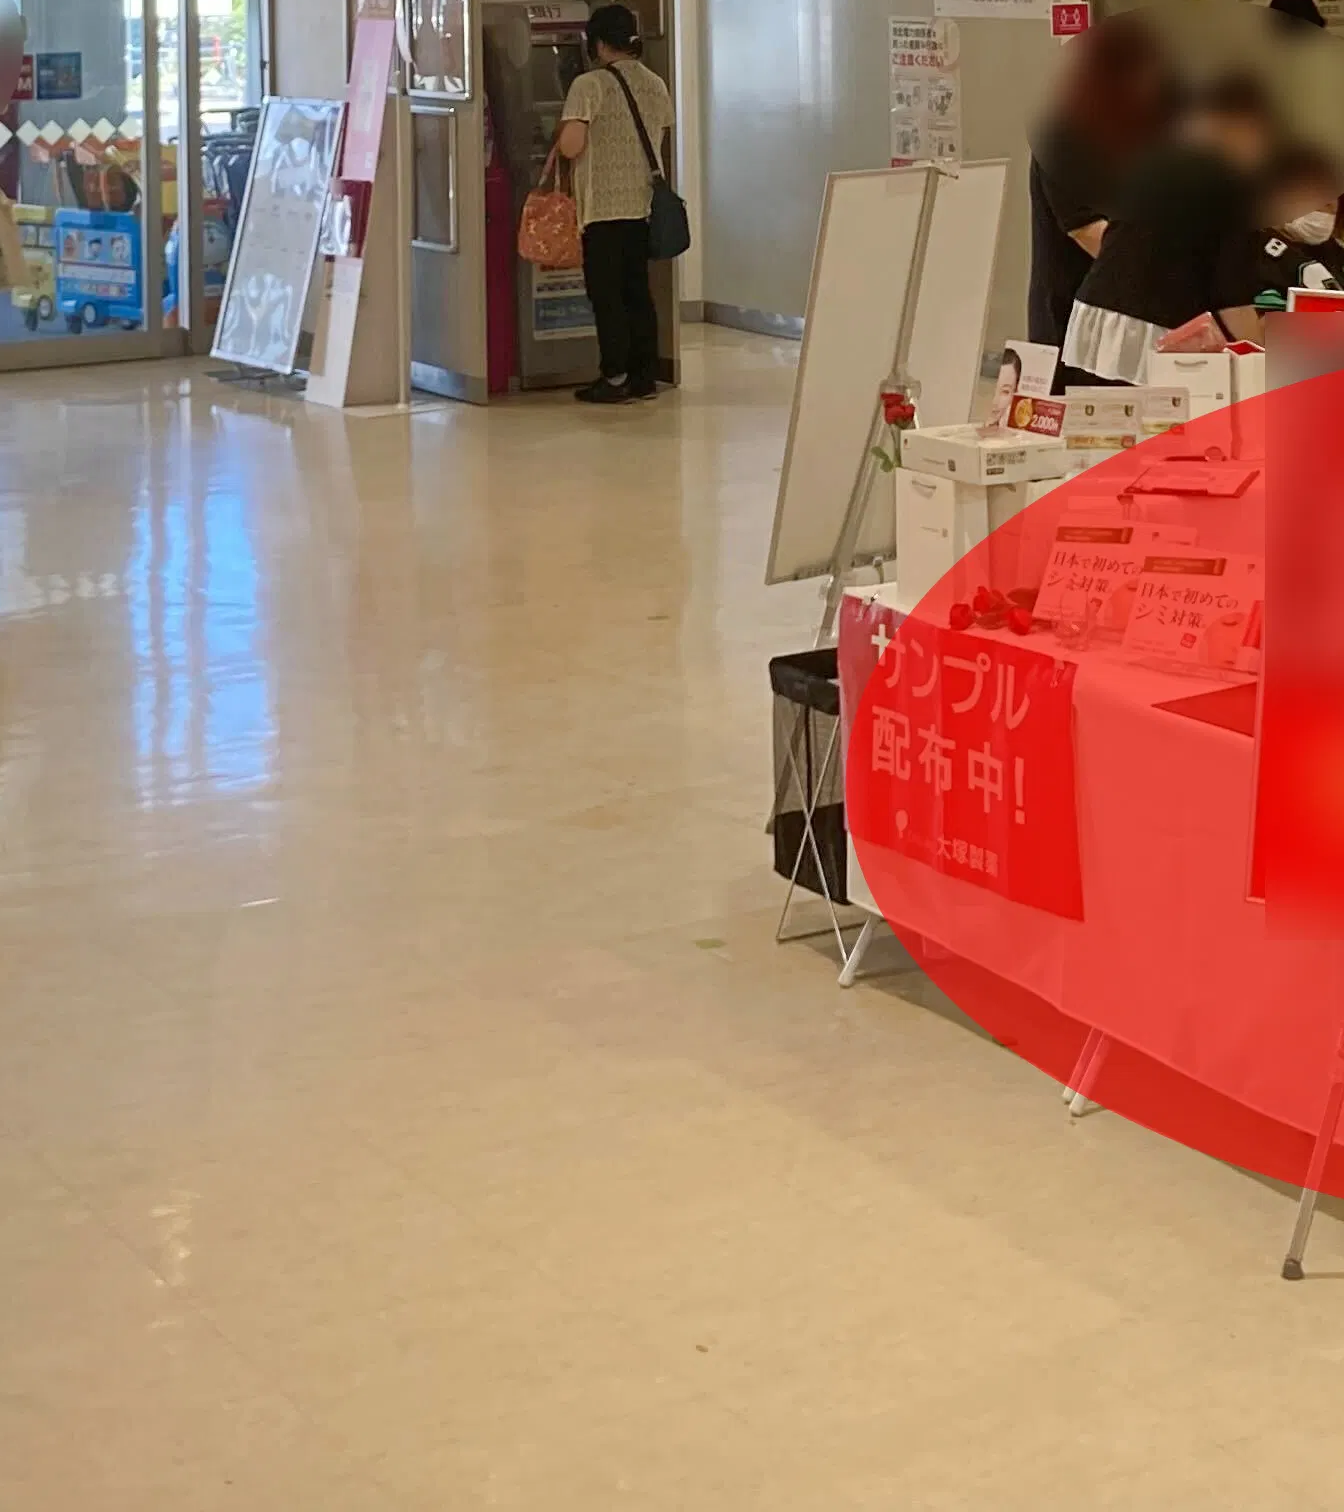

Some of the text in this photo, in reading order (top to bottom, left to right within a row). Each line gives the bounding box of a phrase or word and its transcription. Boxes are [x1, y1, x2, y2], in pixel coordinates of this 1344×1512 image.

[1140, 581, 1239, 610] 日本で初めての
[870, 623, 1031, 731] サンプル
[935, 833, 999, 879] 大塚製薬
